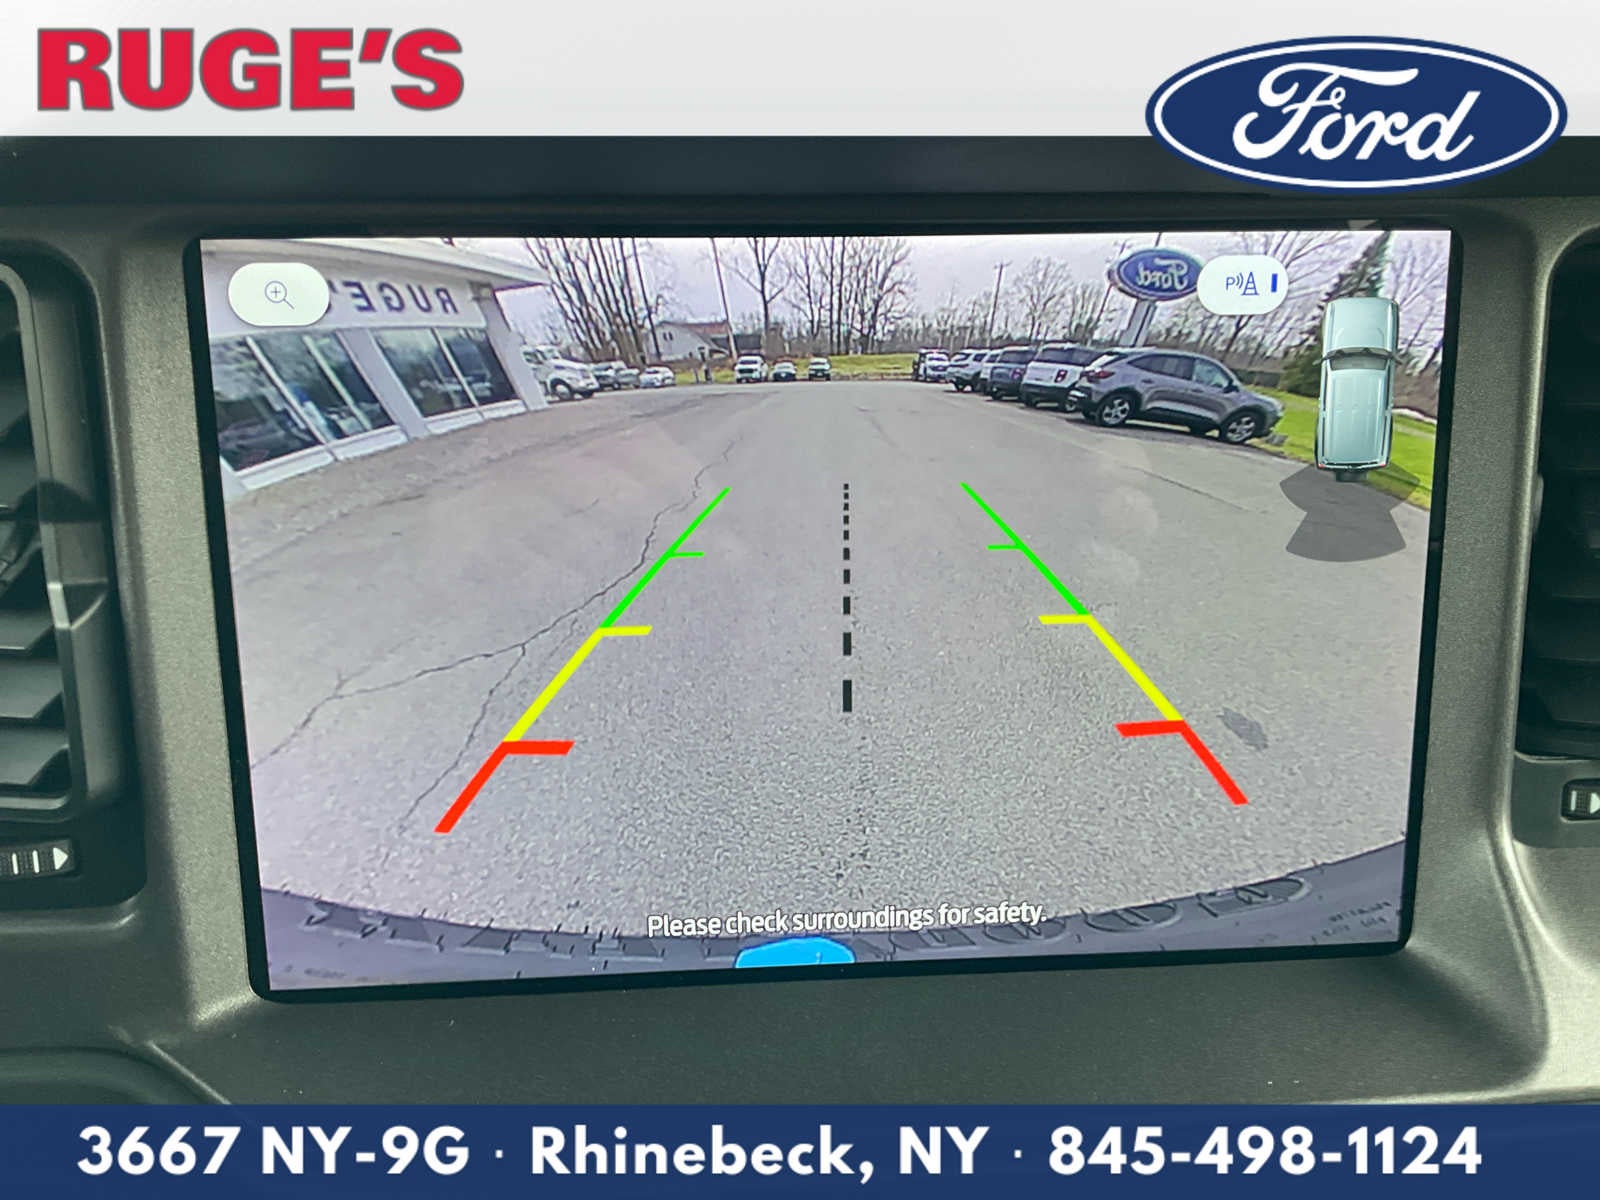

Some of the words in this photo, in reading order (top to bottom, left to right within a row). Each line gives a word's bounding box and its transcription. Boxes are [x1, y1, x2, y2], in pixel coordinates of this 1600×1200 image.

[647, 914, 721, 938] Please
[725, 910, 788, 934] check
[792, 905, 934, 932] surroundings
[937, 904, 970, 926] for
[973, 901, 1048, 925] safety.
